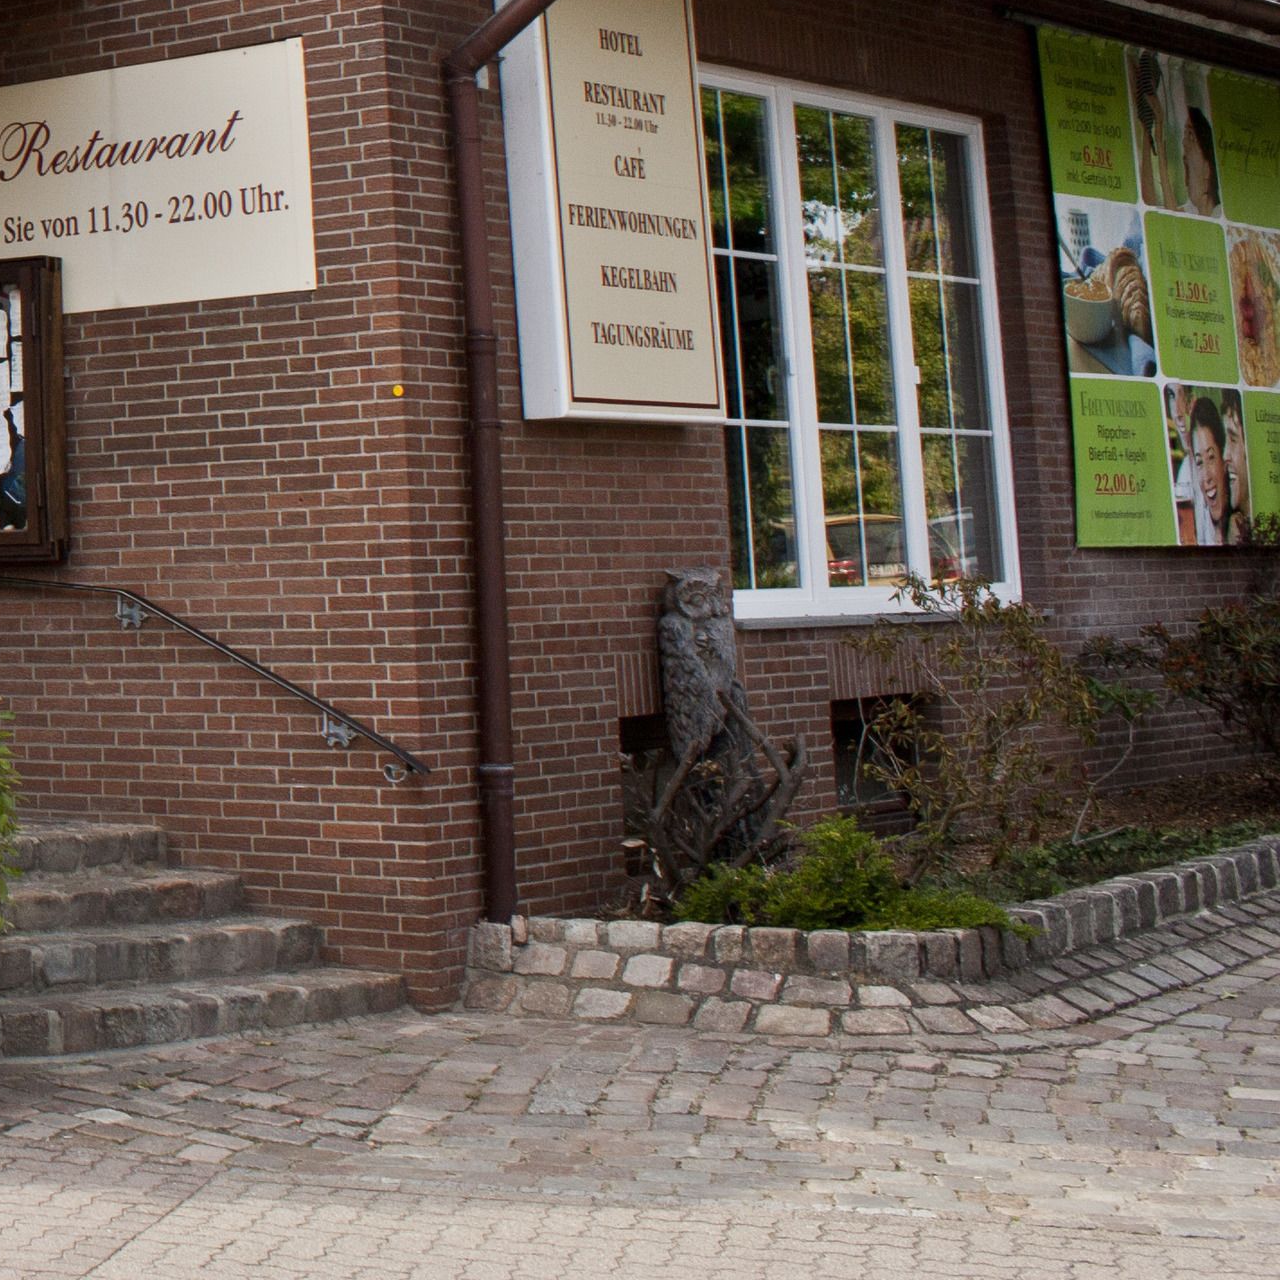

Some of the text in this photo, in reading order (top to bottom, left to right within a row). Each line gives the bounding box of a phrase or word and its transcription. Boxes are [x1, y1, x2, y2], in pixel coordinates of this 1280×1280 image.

[599, 28, 643, 57] HOTEL
[584, 81, 666, 116] RESTAURANT
[614, 147, 646, 179] CAFÉ
[4, 216, 34, 244] Sie
[40, 216, 80, 239] von
[88, 201, 148, 234] 11.30
[168, 191, 232, 224] 22.00
[240, 184, 289, 215] Uhr.
[568, 203, 697, 240] FERIENWOHNUNGEN
[601, 265, 677, 293] KEGELBAHN
[591, 321, 695, 351] TAGUNGSRÄUME
[1094, 473, 1127, 493] 22,00
[1129, 473, 1136, 493] €
